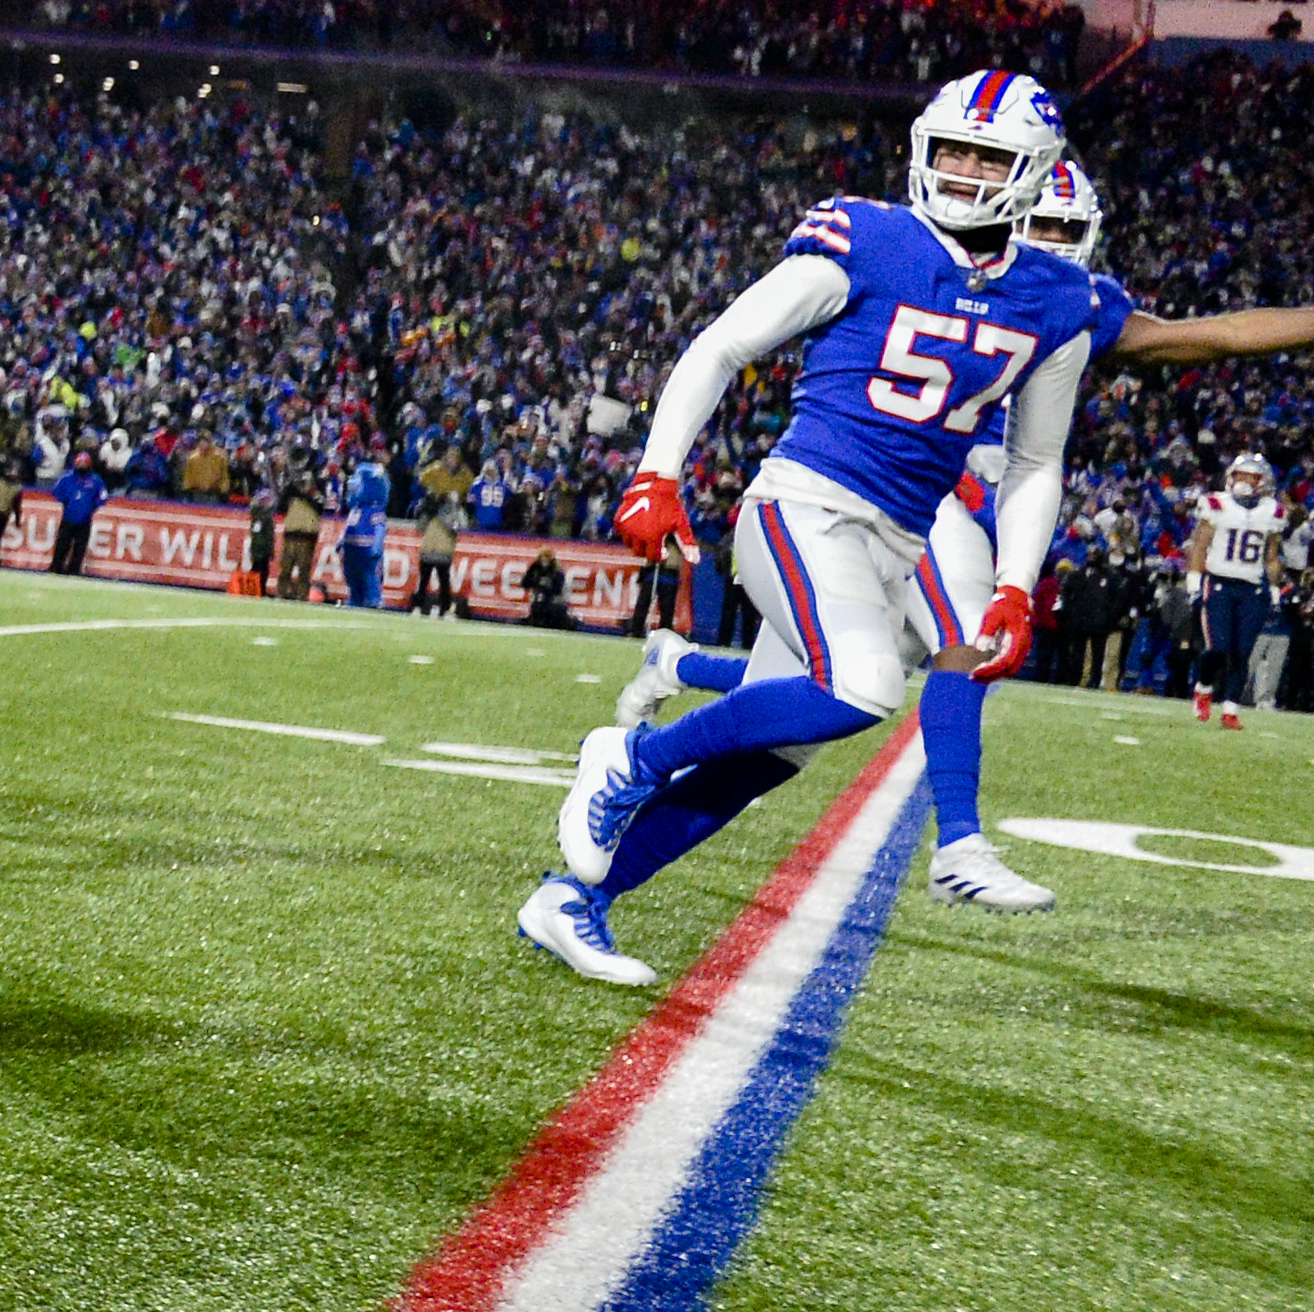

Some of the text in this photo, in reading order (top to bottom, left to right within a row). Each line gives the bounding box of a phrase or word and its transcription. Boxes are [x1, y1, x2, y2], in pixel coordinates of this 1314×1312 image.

[866, 302, 1039, 435] 57
[0, 512, 145, 562] SUER
[1226, 527, 1265, 564] 16
